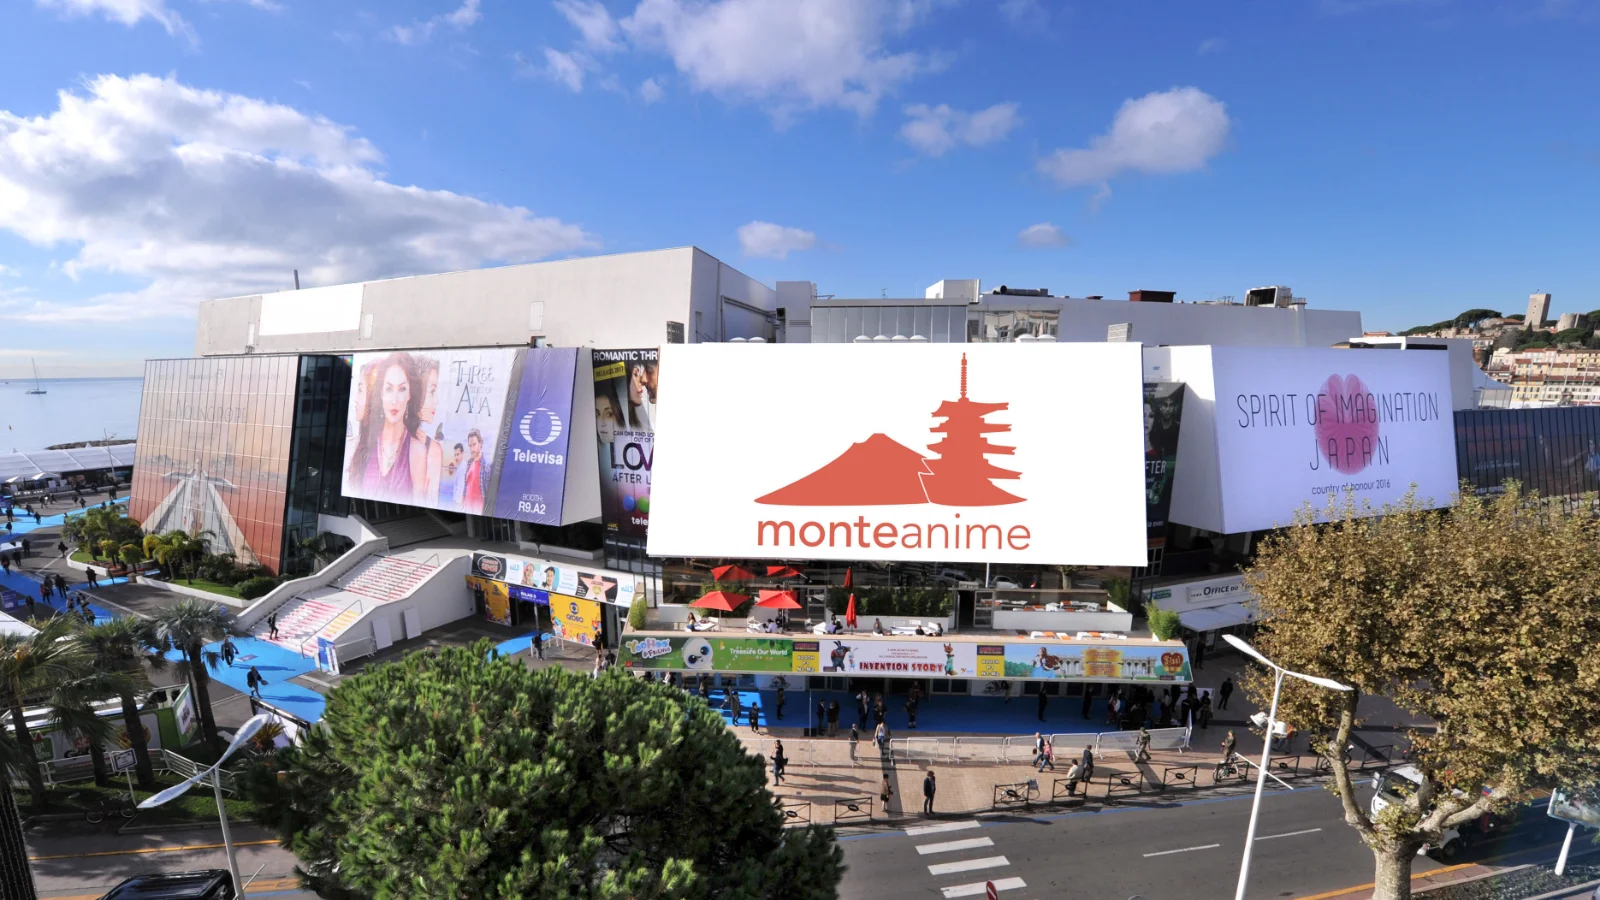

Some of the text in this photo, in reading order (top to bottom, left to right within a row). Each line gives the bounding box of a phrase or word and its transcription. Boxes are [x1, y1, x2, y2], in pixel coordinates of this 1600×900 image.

[593, 350, 658, 361] ROMANTIC THR
[453, 360, 495, 387] THREE
[455, 383, 491, 417] ANA
[1236, 391, 1440, 429] SPIRIT OF IMAGINATION
[513, 448, 564, 465] Televisa
[1309, 435, 1390, 471] JAPAN
[612, 472, 642, 485] AFTER
[1312, 484, 1340, 495] country
[1350, 480, 1375, 492] honour
[1375, 478, 1391, 490] 2016
[518, 501, 547, 515] R9.A2
[757, 512, 1031, 551] monteanime
[1203, 585, 1230, 596] OFFICE
[566, 613, 584, 624] GLOBO
[769, 648, 788, 657] World
[859, 661, 944, 672] INVENTION STORY
